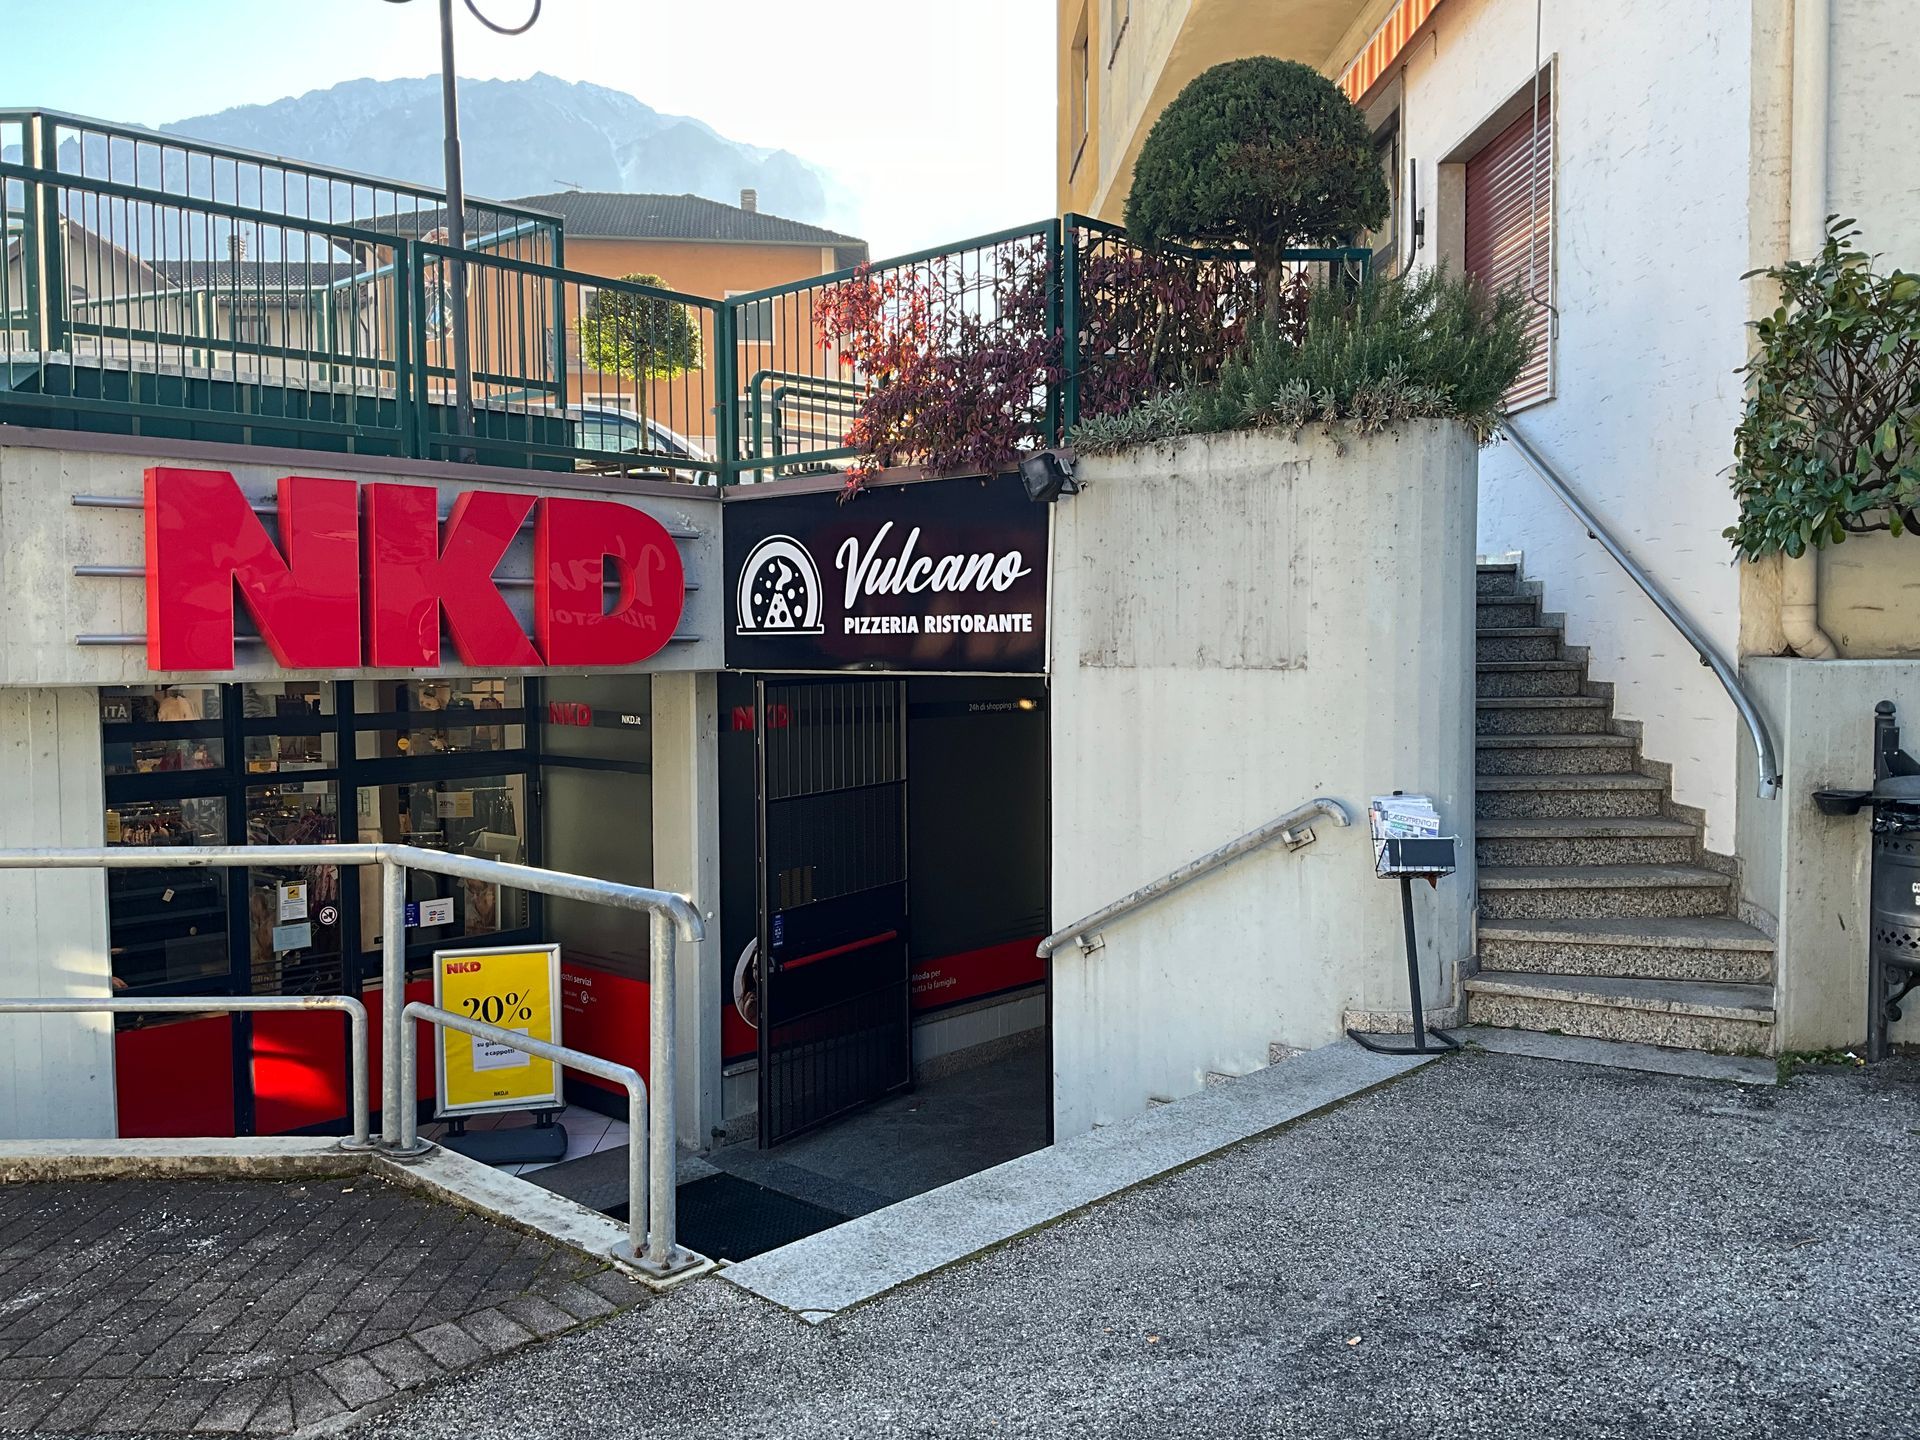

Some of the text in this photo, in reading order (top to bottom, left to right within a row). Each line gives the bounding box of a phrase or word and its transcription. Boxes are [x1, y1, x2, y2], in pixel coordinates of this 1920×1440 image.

[144, 466, 684, 671] NKD
[836, 521, 1032, 610] Vulcano
[844, 613, 1032, 635] PIZZERIA RISTORANTE
[102, 703, 128, 718] ITÀ
[968, 703, 979, 712] 24h
[980, 702, 986, 711] di
[986, 701, 1012, 712] shopping
[549, 702, 592, 727] NKD
[622, 714, 641, 726] NKD.it
[446, 961, 481, 975] NKD
[930, 970, 940, 980] per
[573, 976, 592, 987] servizi
[912, 984, 926, 993] tutta
[934, 978, 956, 990] famiglia
[463, 989, 532, 1024] 20%
[489, 1048, 515, 1057] cappotti
